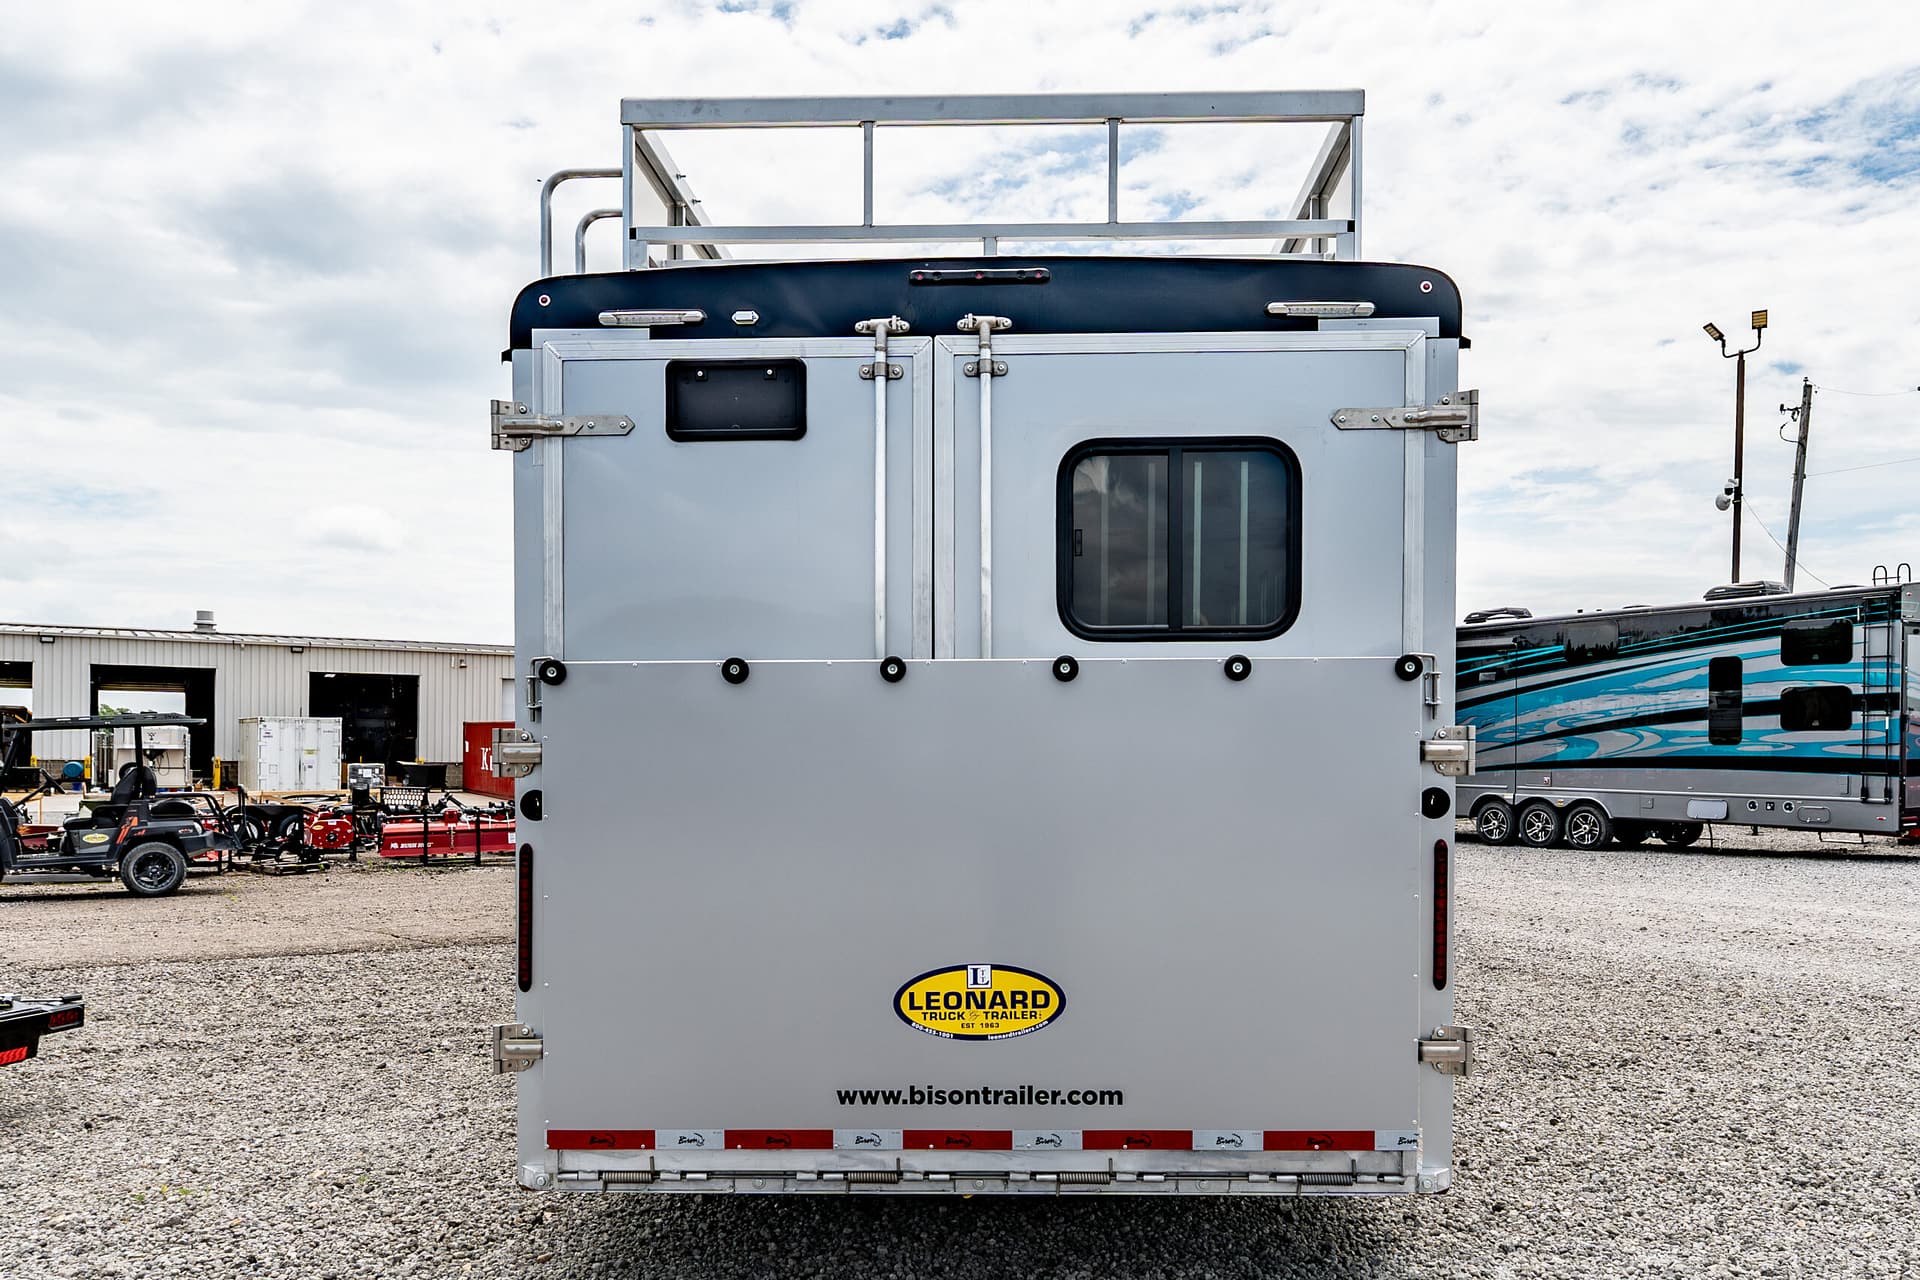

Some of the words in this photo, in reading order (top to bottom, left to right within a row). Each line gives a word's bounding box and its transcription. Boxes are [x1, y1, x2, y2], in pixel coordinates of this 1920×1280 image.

[908, 990, 1051, 1011] LEONARD
[921, 1011, 966, 1021] TRUCK
[983, 1010, 1038, 1020] TRAILER
[836, 1085, 1124, 1106] www.bisontrailer.com
